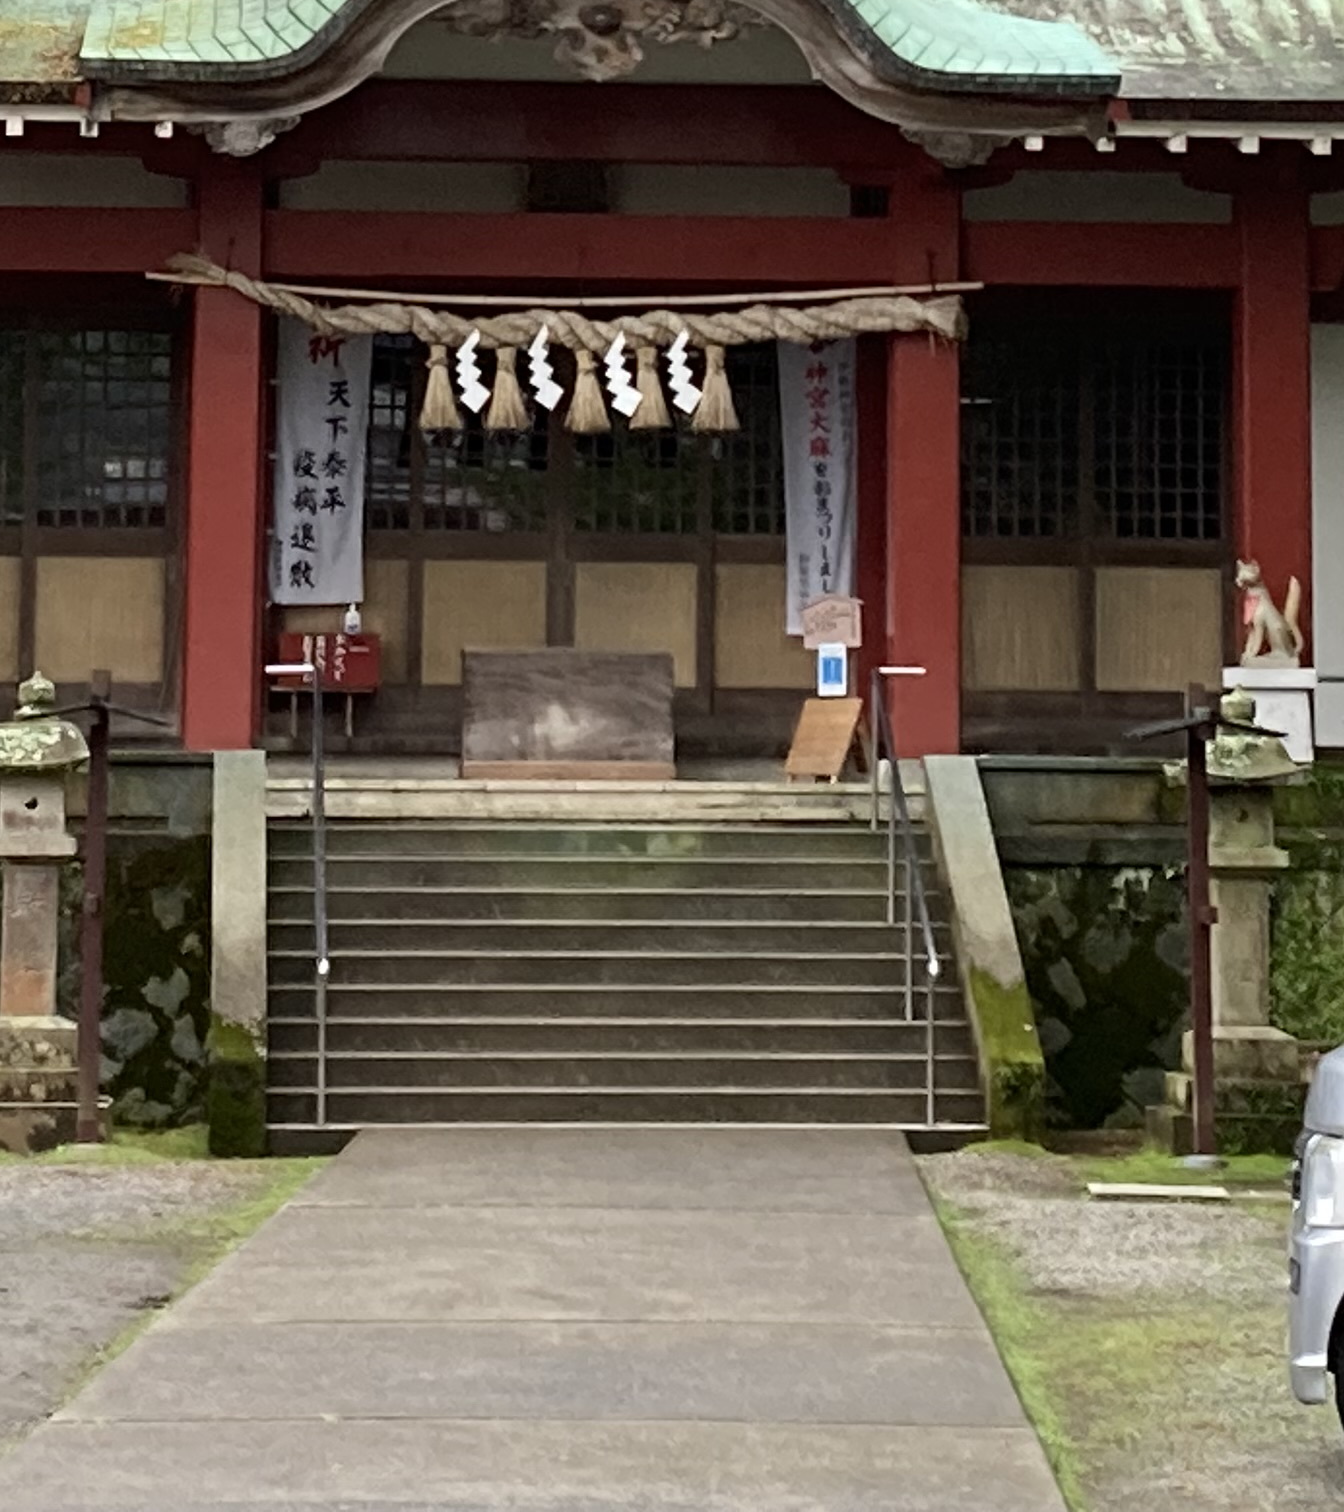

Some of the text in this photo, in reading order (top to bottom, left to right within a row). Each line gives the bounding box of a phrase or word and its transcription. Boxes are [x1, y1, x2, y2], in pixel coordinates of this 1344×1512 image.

[320, 380, 352, 515] 天下泰平
[289, 448, 320, 590] 疫病退散
